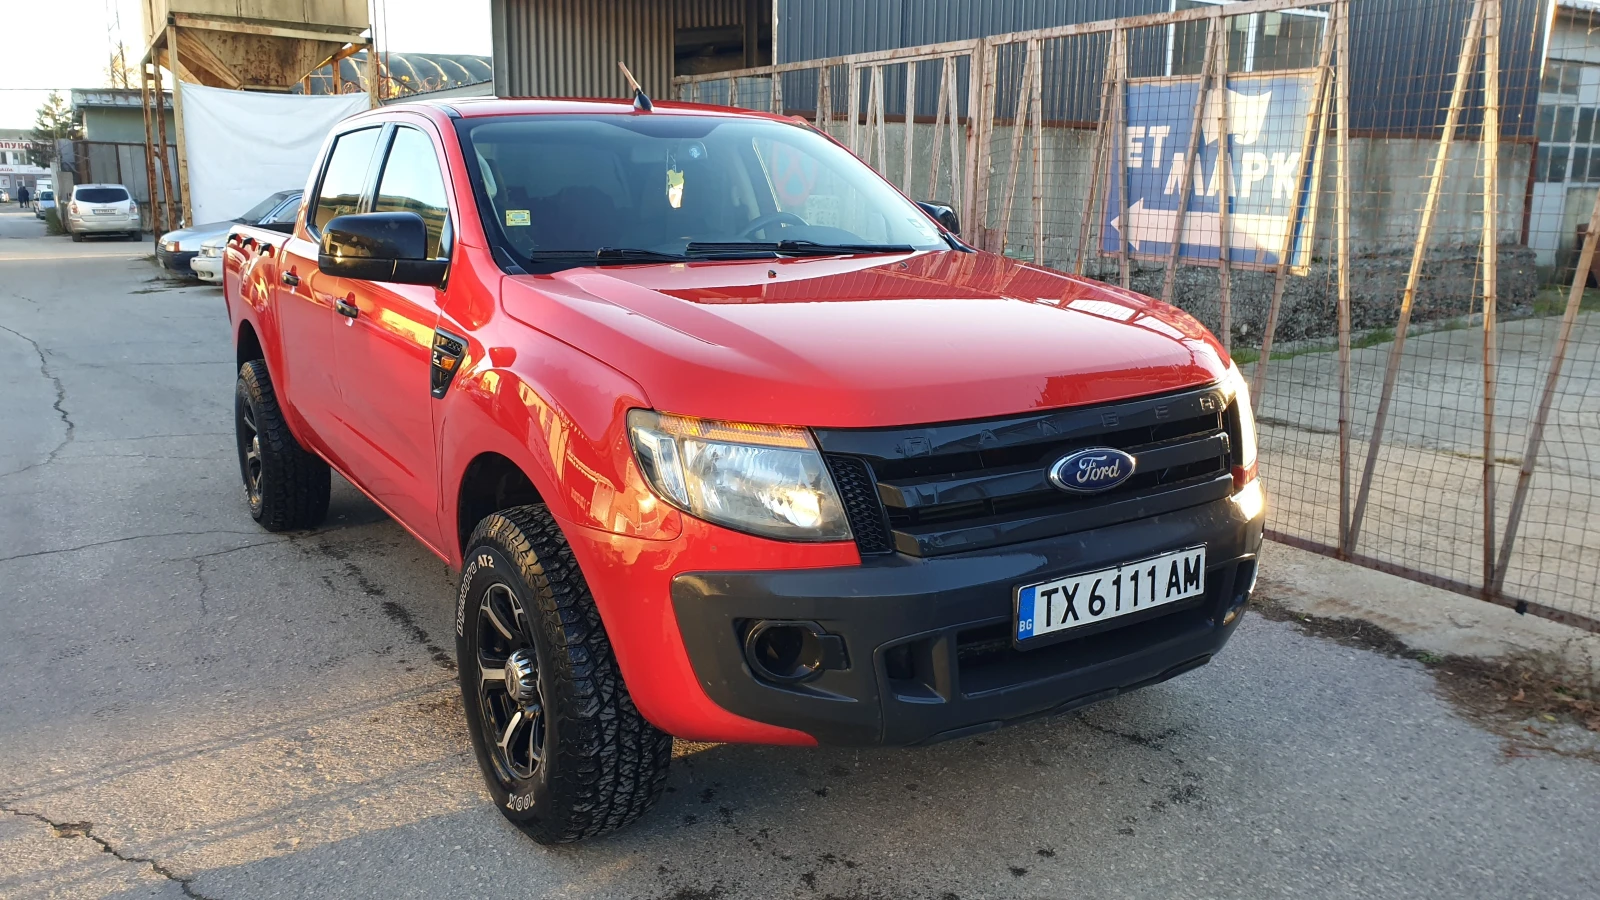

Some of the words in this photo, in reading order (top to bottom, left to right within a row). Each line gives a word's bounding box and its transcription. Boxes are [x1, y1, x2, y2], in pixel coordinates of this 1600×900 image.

[1126, 125, 1171, 169] ЕТ
[1163, 150, 1302, 200] МАРК
[1076, 455, 1120, 484] Ford
[1040, 571, 1080, 629] TX
[1088, 565, 1157, 617] 6111
[1165, 553, 1202, 598] AM
[1019, 619, 1033, 633] BG
